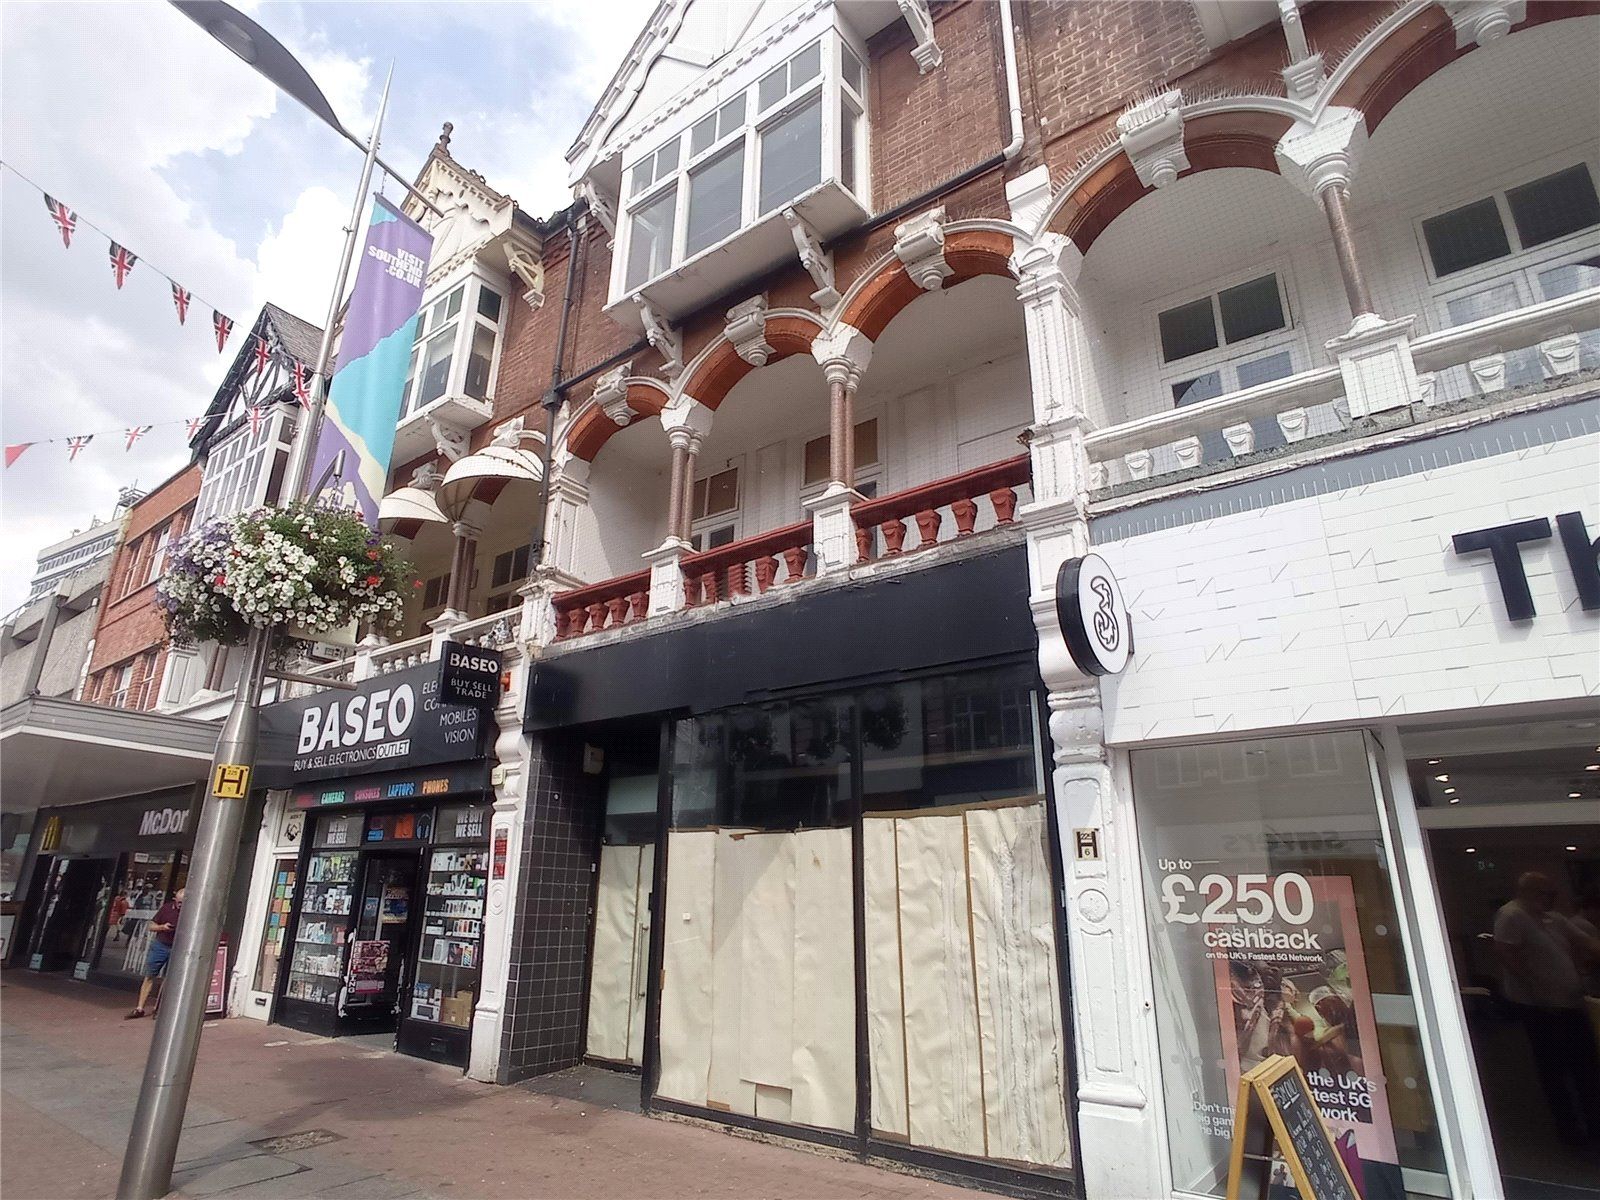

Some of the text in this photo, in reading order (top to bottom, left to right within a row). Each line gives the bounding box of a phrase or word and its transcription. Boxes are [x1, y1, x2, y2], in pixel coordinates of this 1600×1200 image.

[368, 245, 423, 278] SOUTHEND
[397, 248, 425, 269] VISIT
[385, 265, 421, 288] .CO.UK
[450, 653, 498, 673] BASEO
[451, 678, 493, 692] BUY SELL
[455, 687, 487, 699] TRADE
[297, 683, 415, 754] BASEO
[440, 707, 477, 726] MOBILES
[445, 728, 475, 743] VISION
[293, 740, 410, 771] BUY & SELL ELECTRONICS OUTLET
[321, 791, 345, 804] CAMERAS
[354, 787, 380, 800] CONSOLES
[387, 782, 415, 796] LAPTOPS
[422, 779, 449, 794] PHONES
[457, 810, 484, 823] WE BUY
[455, 823, 482, 837] WE SELL
[1158, 859, 1192, 872] Up to
[1161, 872, 1314, 925] £250
[1203, 928, 1322, 950] cashback
[1216, 951, 1228, 959] the
[1229, 952, 1247, 960] UK's
[1248, 952, 1276, 961] Fastest
[1276, 953, 1288, 961] 5G
[1289, 954, 1323, 962] Network
[1307, 1071, 1377, 1092] the UK's
[1194, 1101, 1220, 1113] Don't
[1313, 1088, 1373, 1108] test 5G
[1212, 1116, 1235, 1126] gam
[1320, 1107, 1359, 1122] work
[1213, 1126, 1230, 1140] big
